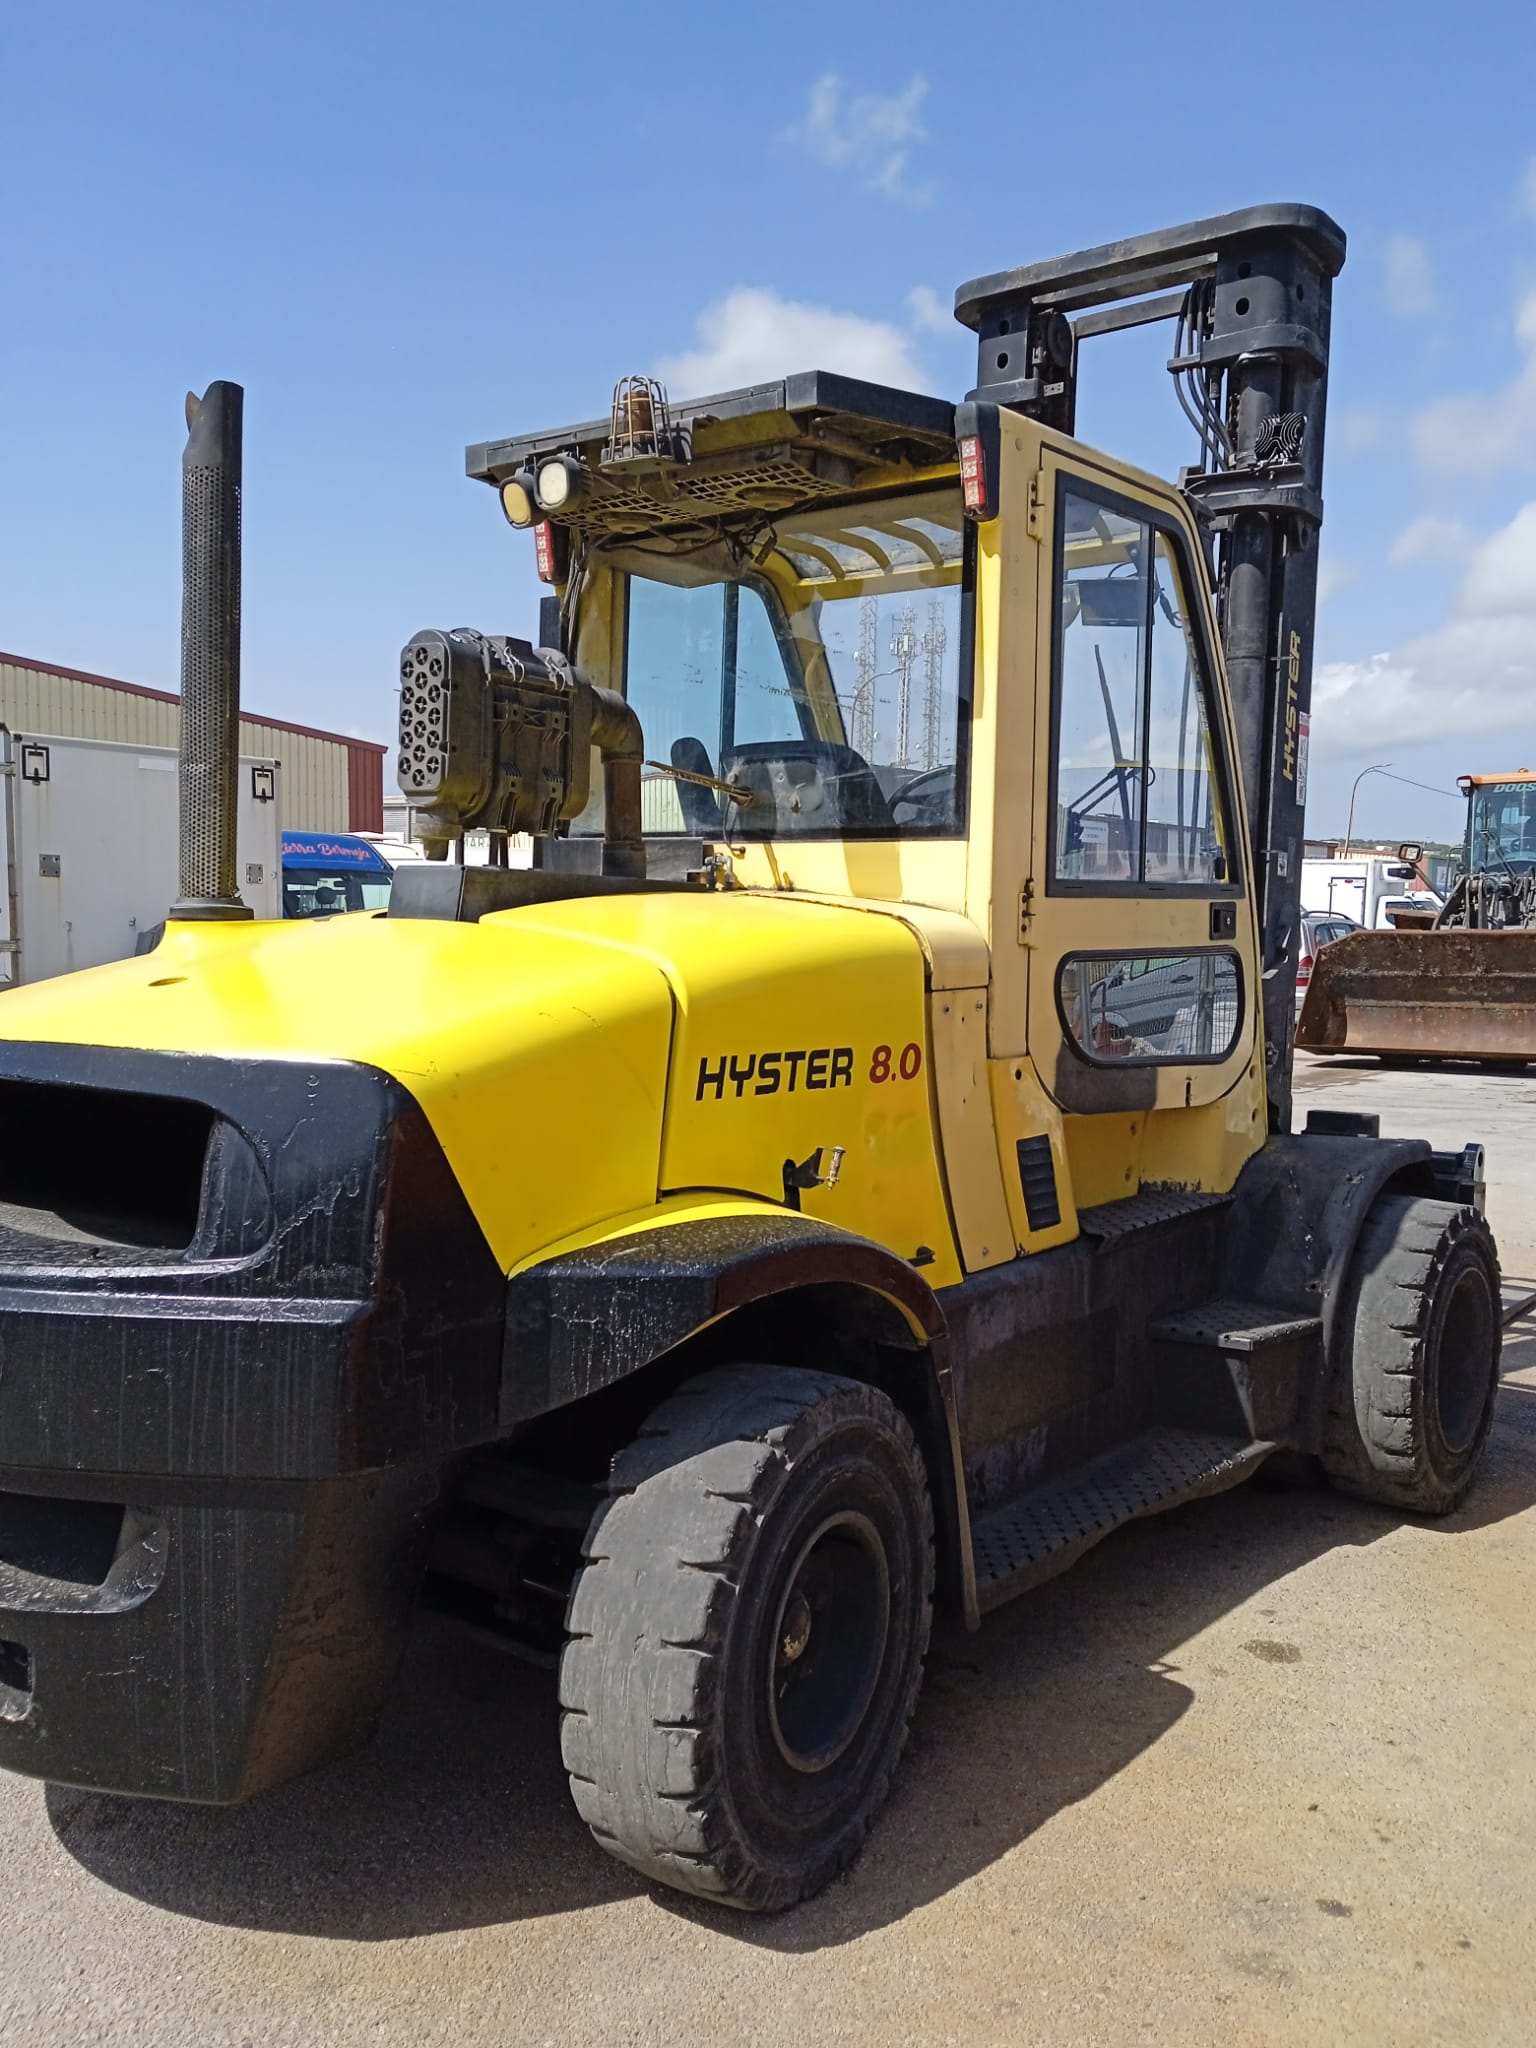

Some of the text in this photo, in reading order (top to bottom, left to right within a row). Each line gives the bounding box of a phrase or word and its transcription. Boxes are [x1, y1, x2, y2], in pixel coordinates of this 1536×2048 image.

[1282, 629, 1302, 782] HYSTER
[695, 1042, 922, 1102] HYSTER 8.0
